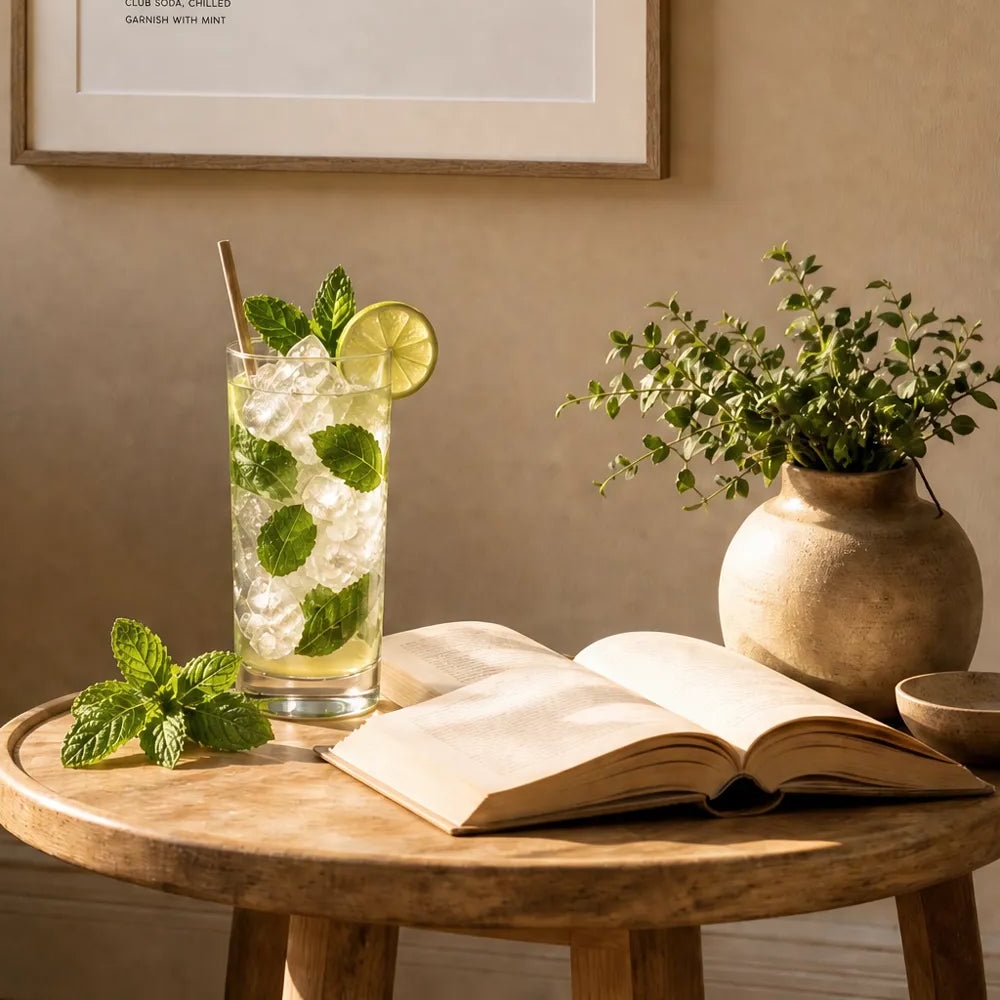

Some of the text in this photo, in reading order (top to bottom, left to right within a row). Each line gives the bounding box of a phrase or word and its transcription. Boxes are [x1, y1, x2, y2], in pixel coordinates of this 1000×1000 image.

[125, 14, 226, 25] GARNISH WITH MINT
